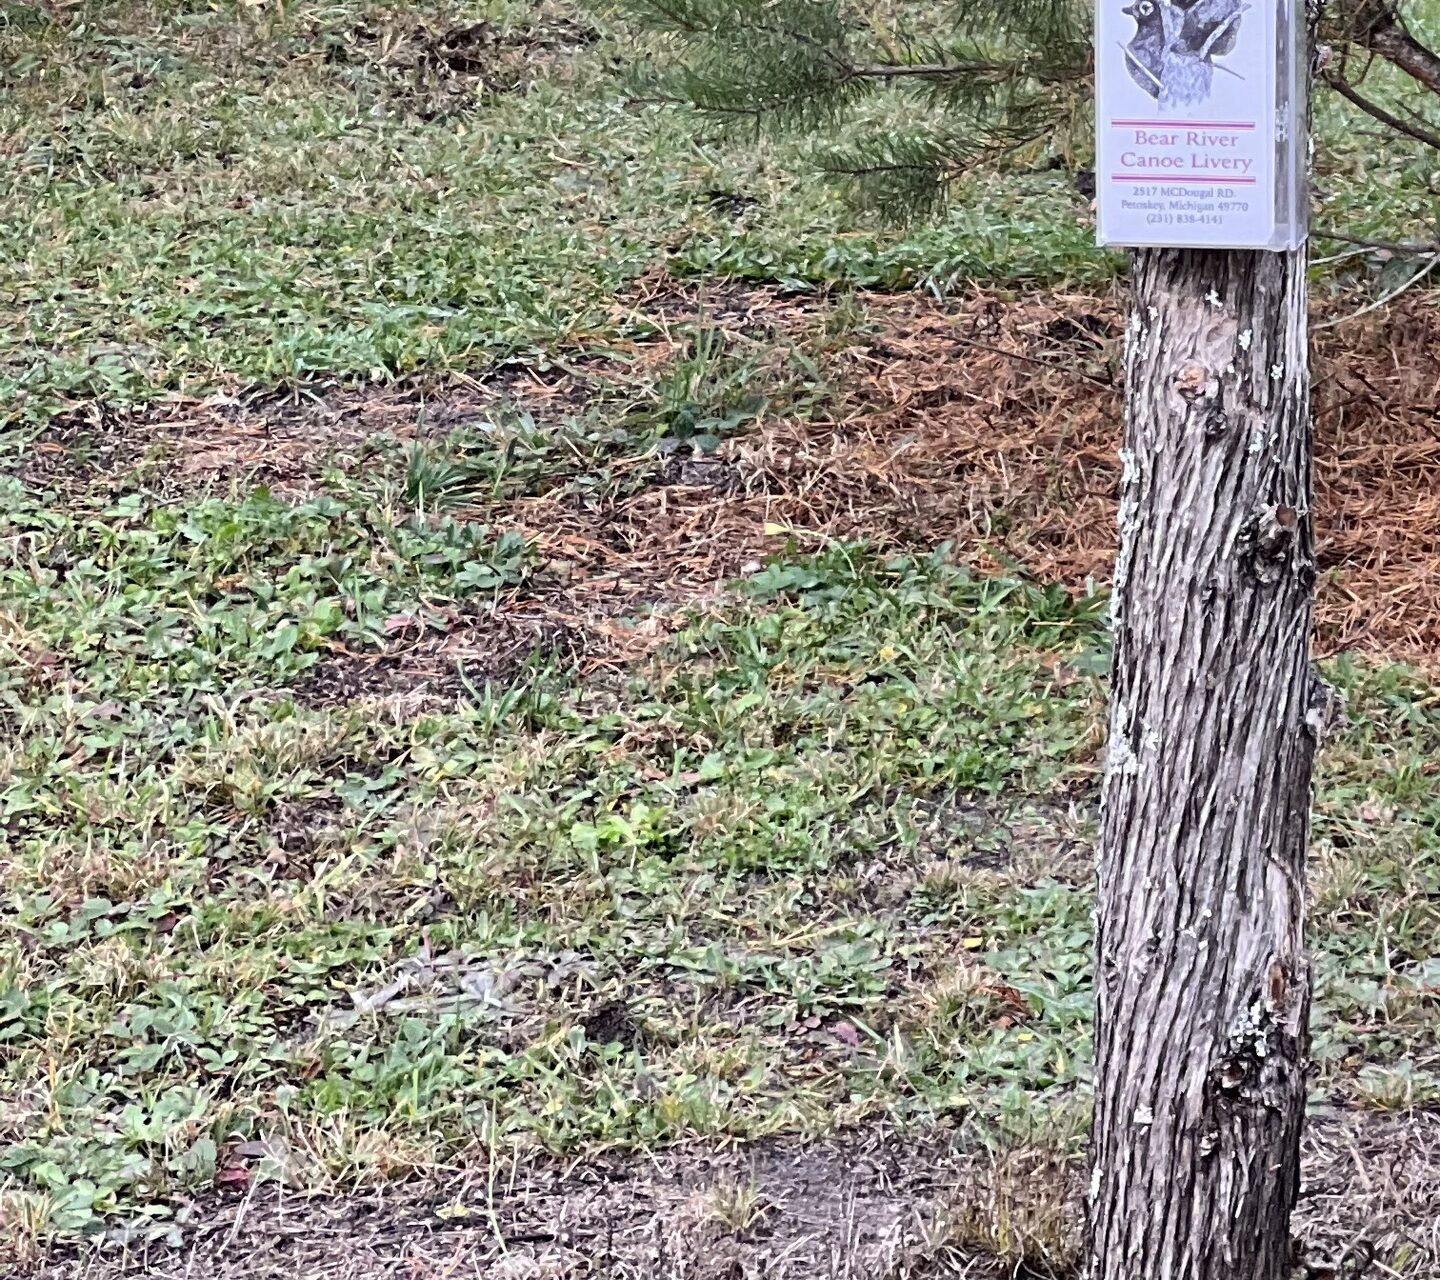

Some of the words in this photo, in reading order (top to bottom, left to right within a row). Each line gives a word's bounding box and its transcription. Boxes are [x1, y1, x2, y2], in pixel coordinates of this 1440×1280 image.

[1134, 130, 1179, 146] Bear
[1186, 131, 1239, 147] River
[1120, 152, 1184, 168] Canoe
[1191, 154, 1253, 173] Livery
[1121, 200, 1165, 212] Petoskey,
[1168, 201, 1214, 213] Michigan
[1217, 203, 1249, 212] 49770
[1146, 214, 1173, 225] (231)
